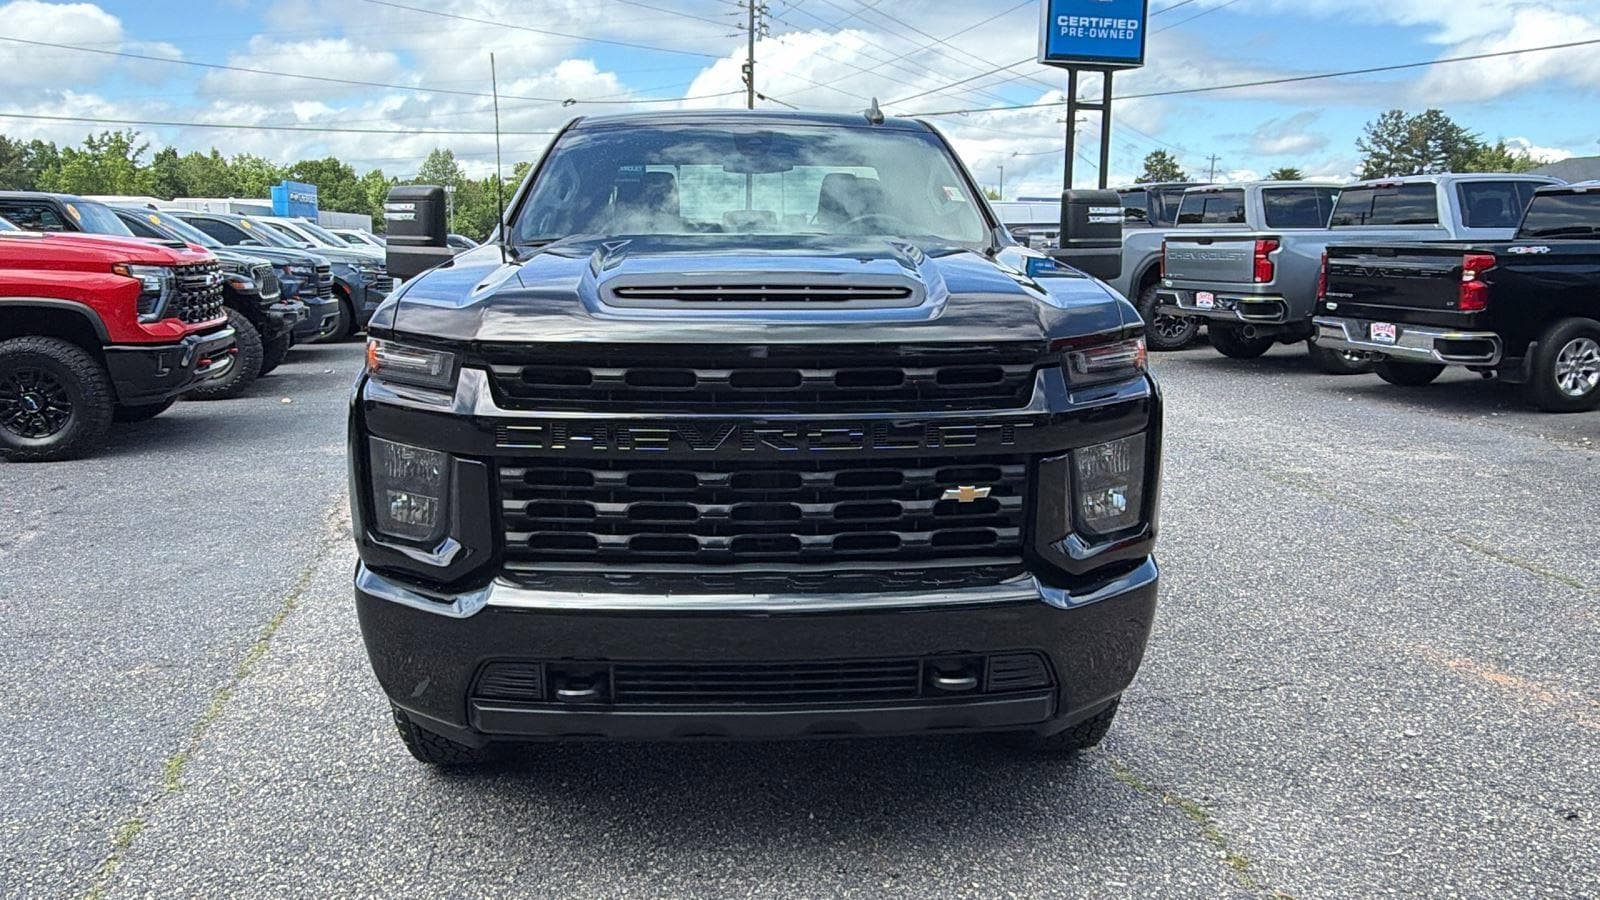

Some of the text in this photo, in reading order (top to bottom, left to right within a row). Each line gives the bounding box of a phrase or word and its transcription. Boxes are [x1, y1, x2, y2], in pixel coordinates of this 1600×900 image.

[1057, 15, 1139, 30] CERTIFIED
[1060, 26, 1134, 40] PRE-OWNED
[495, 422, 1034, 451] CHEVROLET
